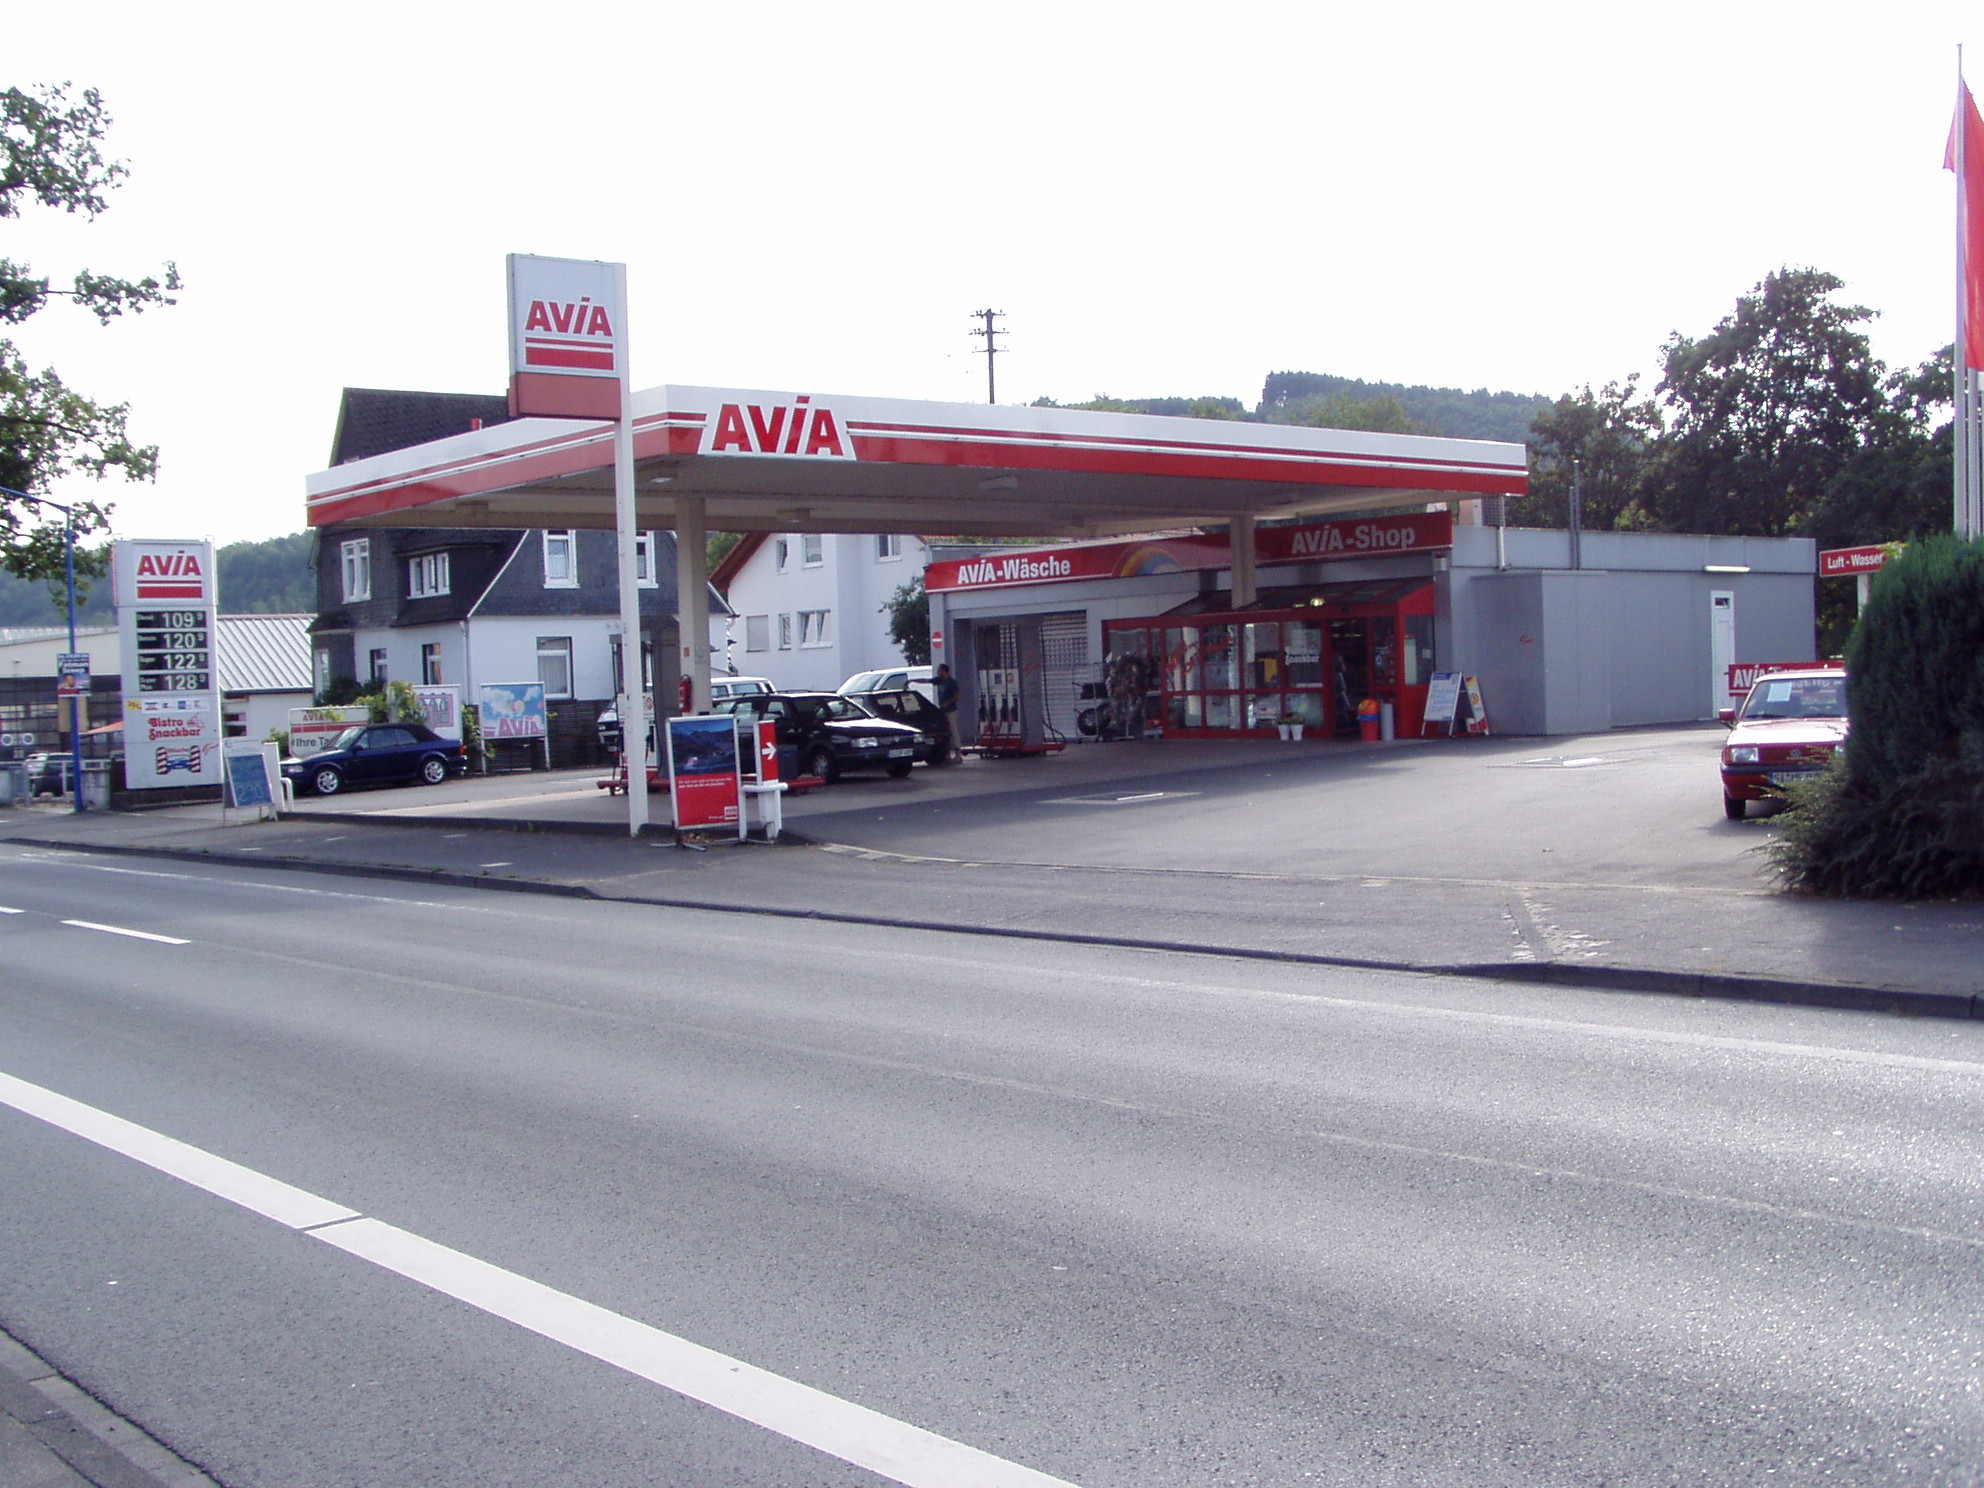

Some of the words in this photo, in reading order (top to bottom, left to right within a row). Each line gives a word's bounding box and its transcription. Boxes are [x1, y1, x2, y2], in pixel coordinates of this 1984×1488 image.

[525, 296, 613, 337] AVIA
[711, 395, 844, 456] AVIA
[1291, 525, 1415, 554] AVIA-Shop
[137, 550, 202, 576] AVIA
[1827, 556, 1845, 569] Luft
[1851, 554, 1883, 567] Wasser
[957, 556, 1071, 585] AVIA-Wäsche
[163, 612, 194, 628] 109
[164, 633, 196, 649] 120
[164, 654, 196, 669] 122
[165, 674, 198, 690] 128
[148, 716, 183, 727] Bistro
[148, 727, 201, 741] Snackbar
[296, 737, 317, 748] Ihre
